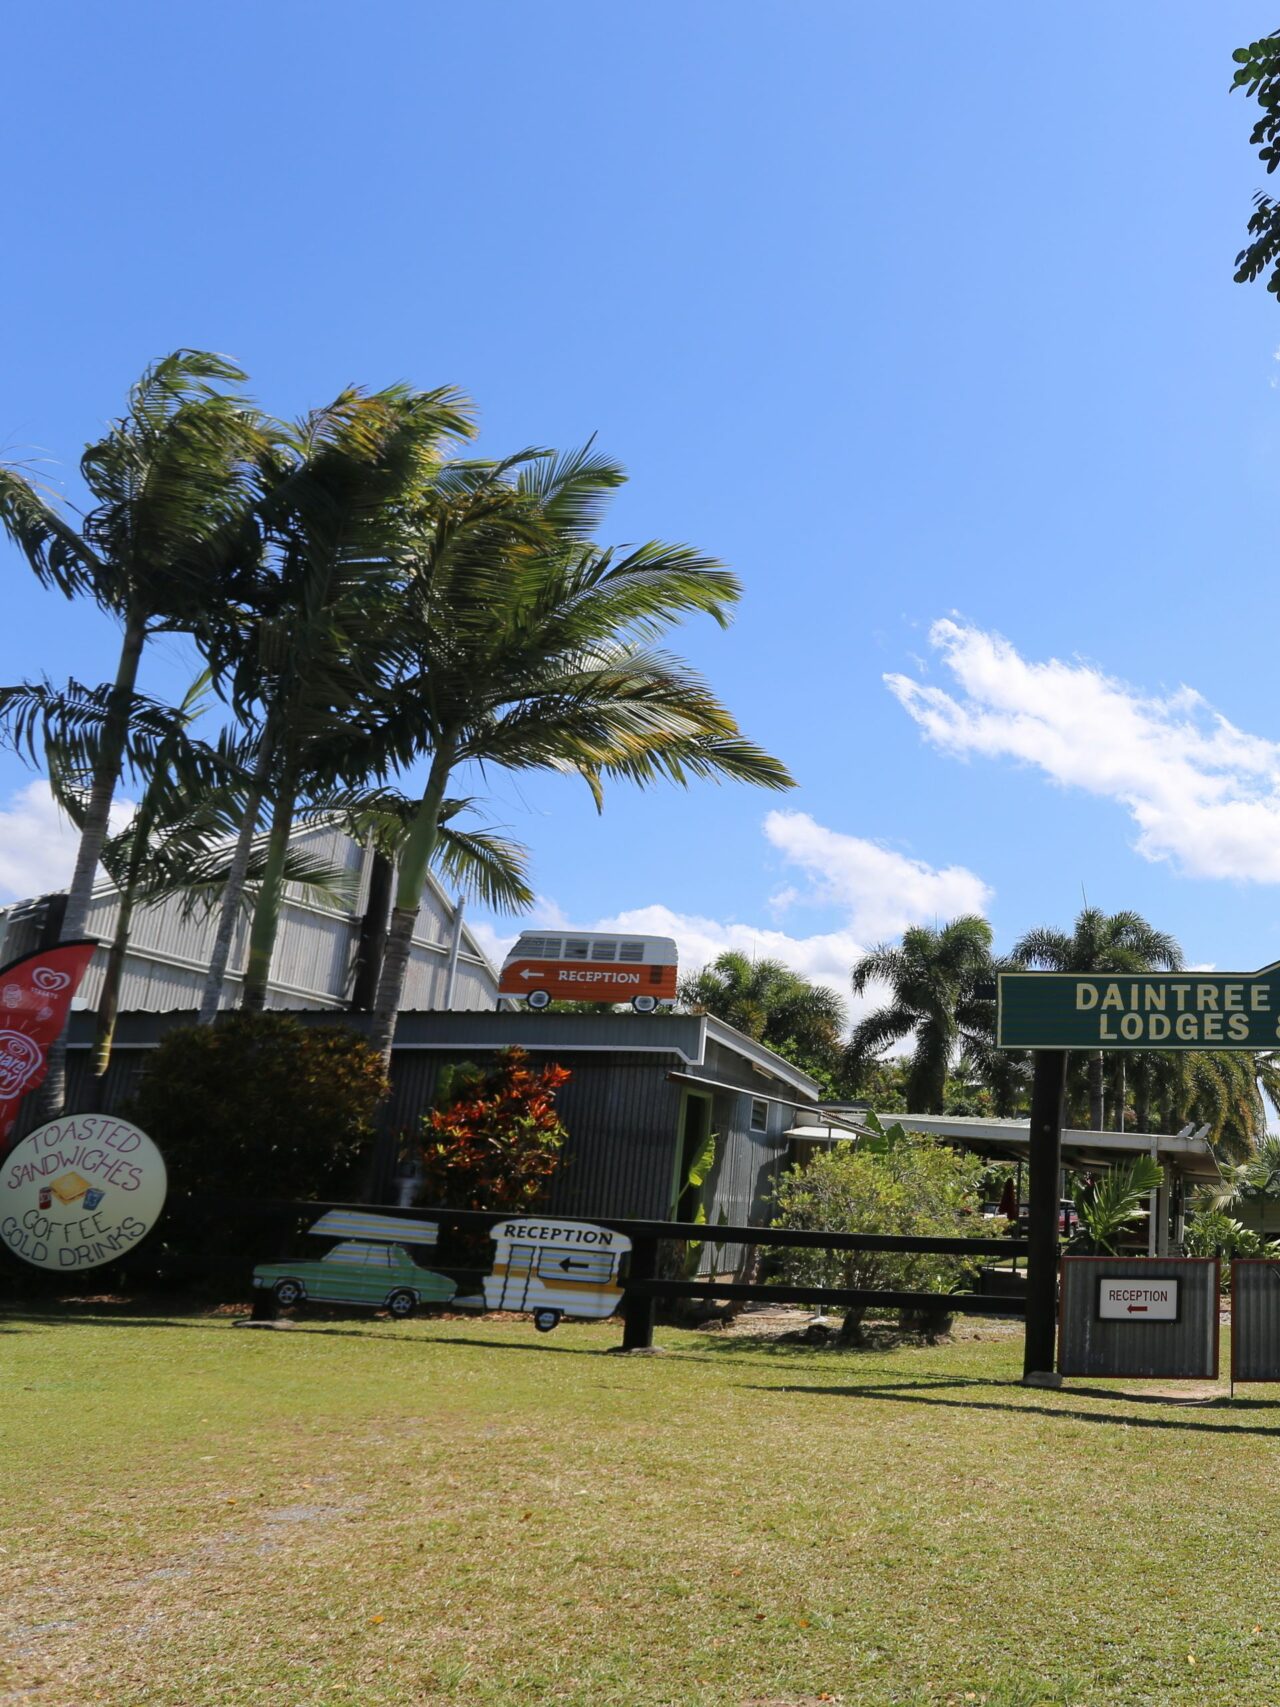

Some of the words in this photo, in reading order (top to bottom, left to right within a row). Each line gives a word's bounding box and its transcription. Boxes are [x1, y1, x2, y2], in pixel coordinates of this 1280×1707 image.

[558, 970, 641, 984] RECEPTION
[1075, 983, 1271, 1011] DAINTREE
[1099, 1013, 1250, 1040] LODGES
[26, 1118, 141, 1154] TOASTED
[7, 1145, 143, 1191] SANDWICHES
[23, 1209, 112, 1243] COFFEE
[503, 1224, 613, 1246] RECEPTION
[1, 1216, 48, 1262] COLD
[59, 1216, 146, 1266] DRINKS
[1108, 1289, 1168, 1302] RECEPTION
